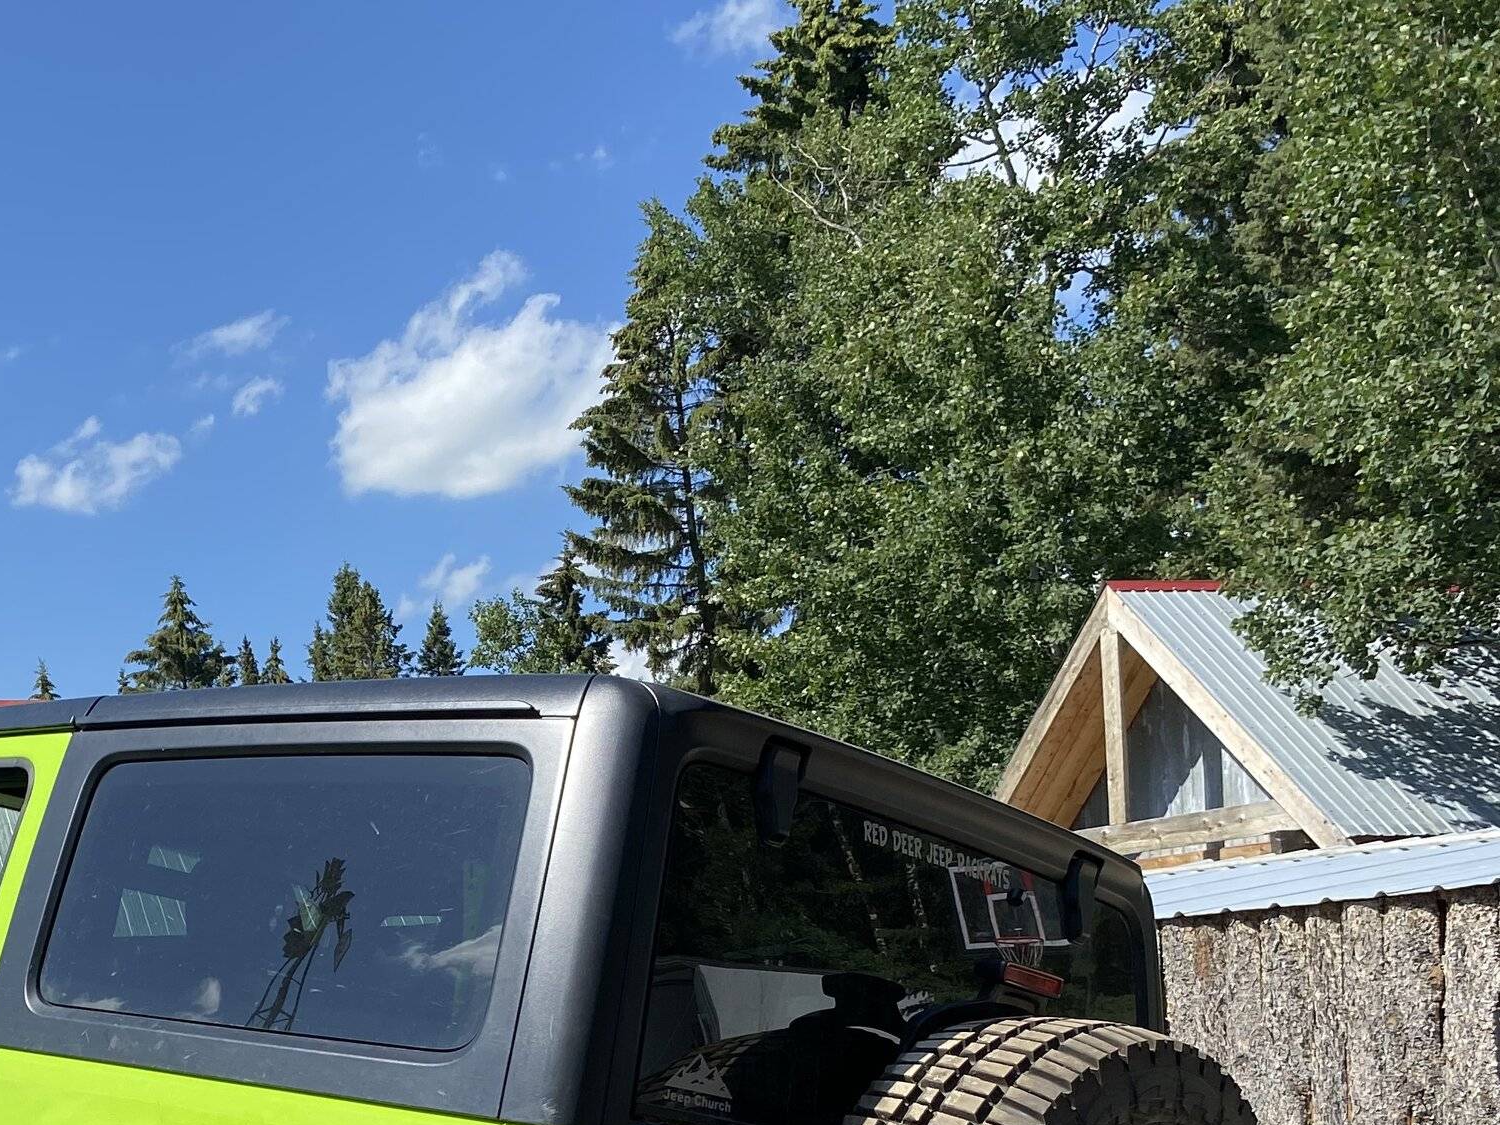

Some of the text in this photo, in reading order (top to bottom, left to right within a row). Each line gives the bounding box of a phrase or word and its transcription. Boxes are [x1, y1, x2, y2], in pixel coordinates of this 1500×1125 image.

[863, 820, 888, 847] RED
[891, 830, 922, 859] DEER
[926, 842, 953, 868] JEEP
[663, 1089, 732, 1113] Jeep Church
